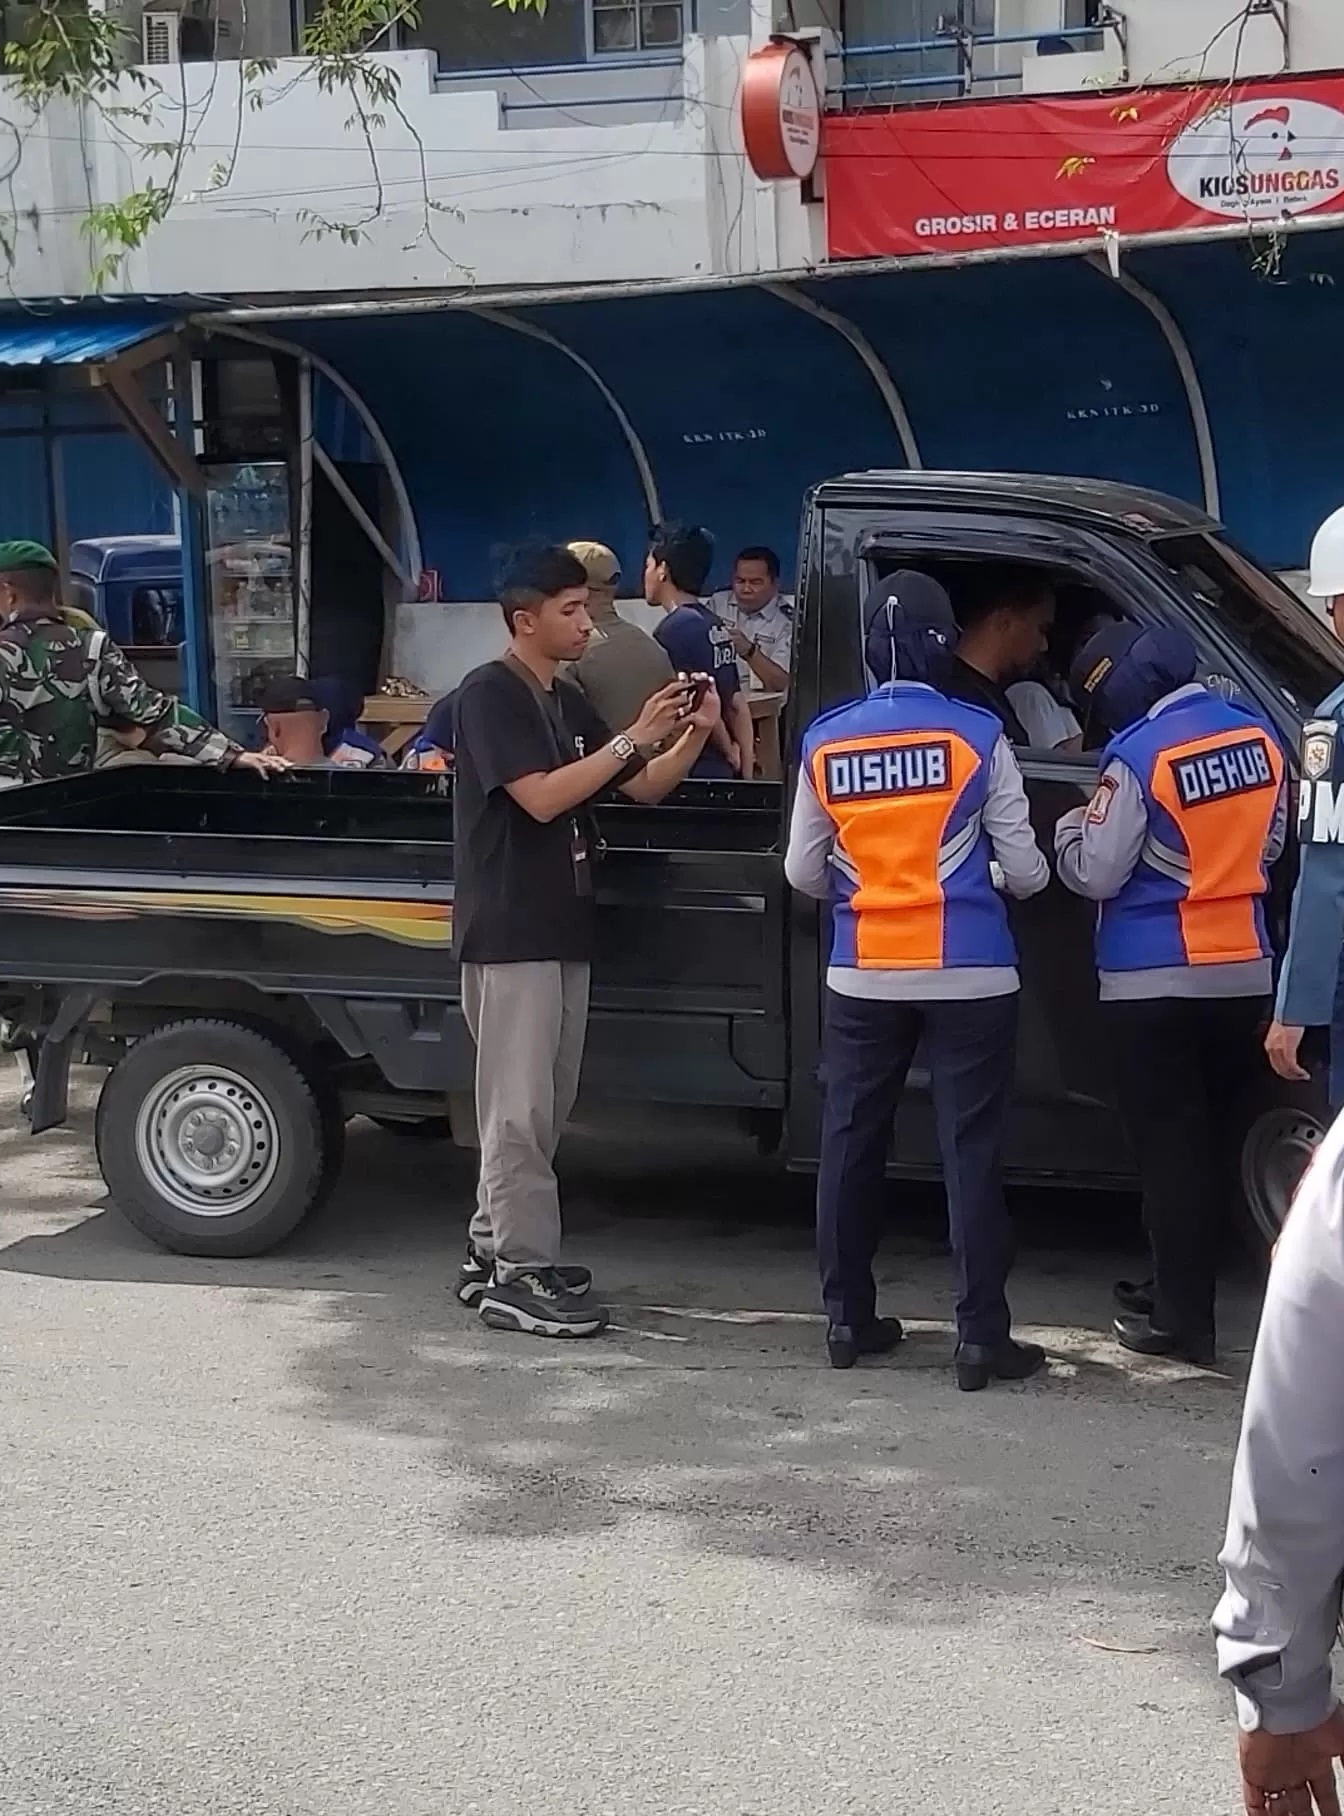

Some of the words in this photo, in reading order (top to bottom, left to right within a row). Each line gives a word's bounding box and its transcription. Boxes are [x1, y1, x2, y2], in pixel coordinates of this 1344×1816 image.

[915, 213, 998, 236] GROSIR
[1003, 213, 1019, 231] &
[1025, 205, 1116, 229] ECERAN
[830, 747, 946, 796] DISHUB
[1179, 744, 1271, 802] DISHUB
